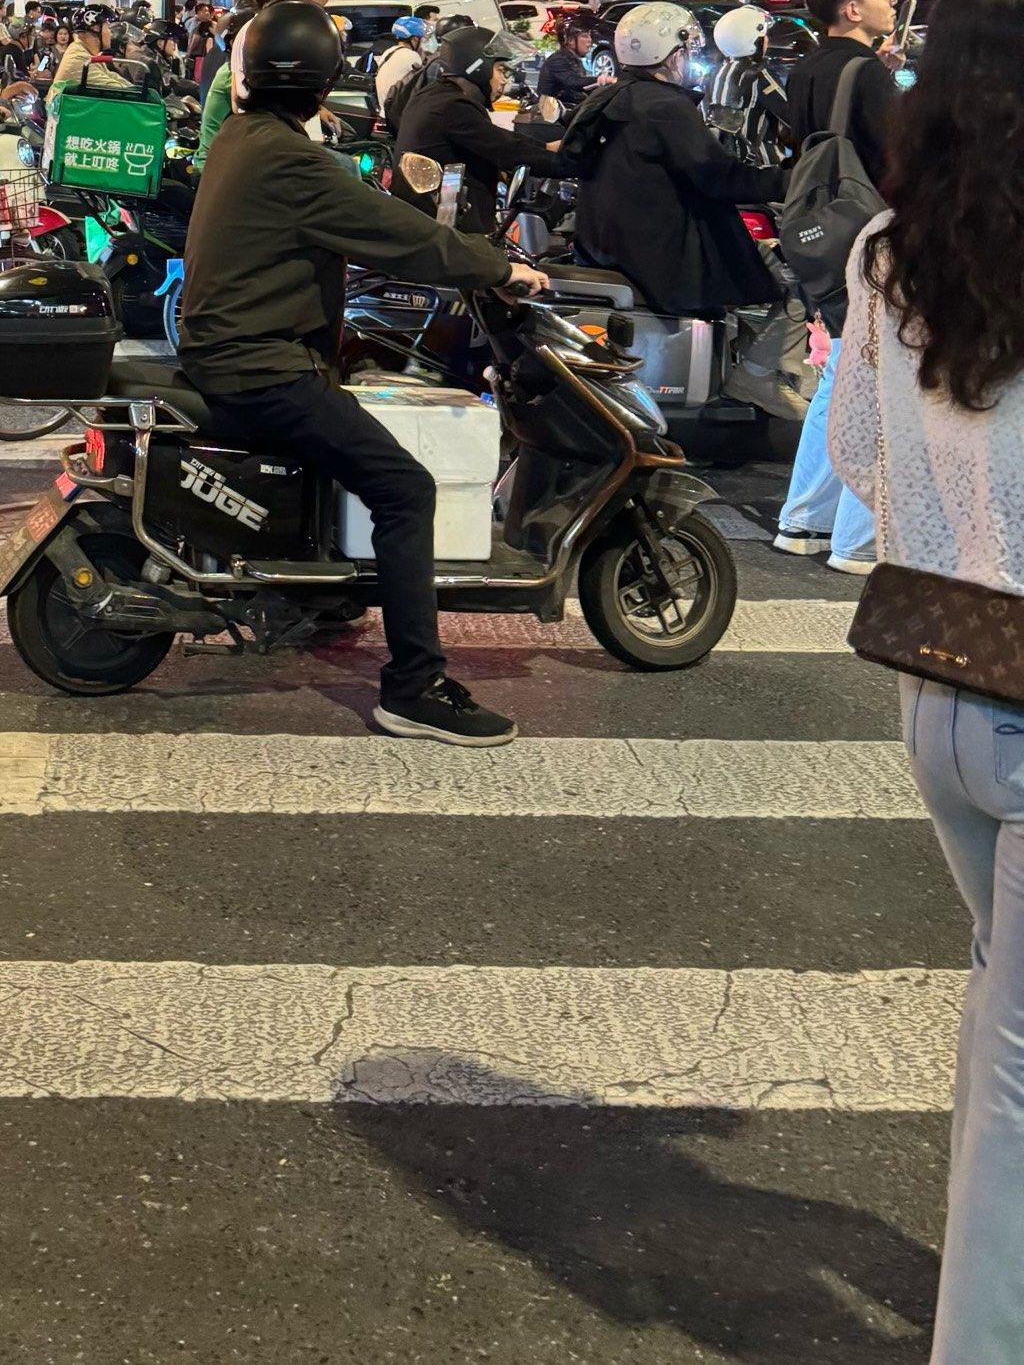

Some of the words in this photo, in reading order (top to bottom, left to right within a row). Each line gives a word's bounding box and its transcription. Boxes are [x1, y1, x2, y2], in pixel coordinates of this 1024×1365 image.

[65, 135, 121, 155] 想吃火锅
[64, 152, 120, 171] 就上叮咚
